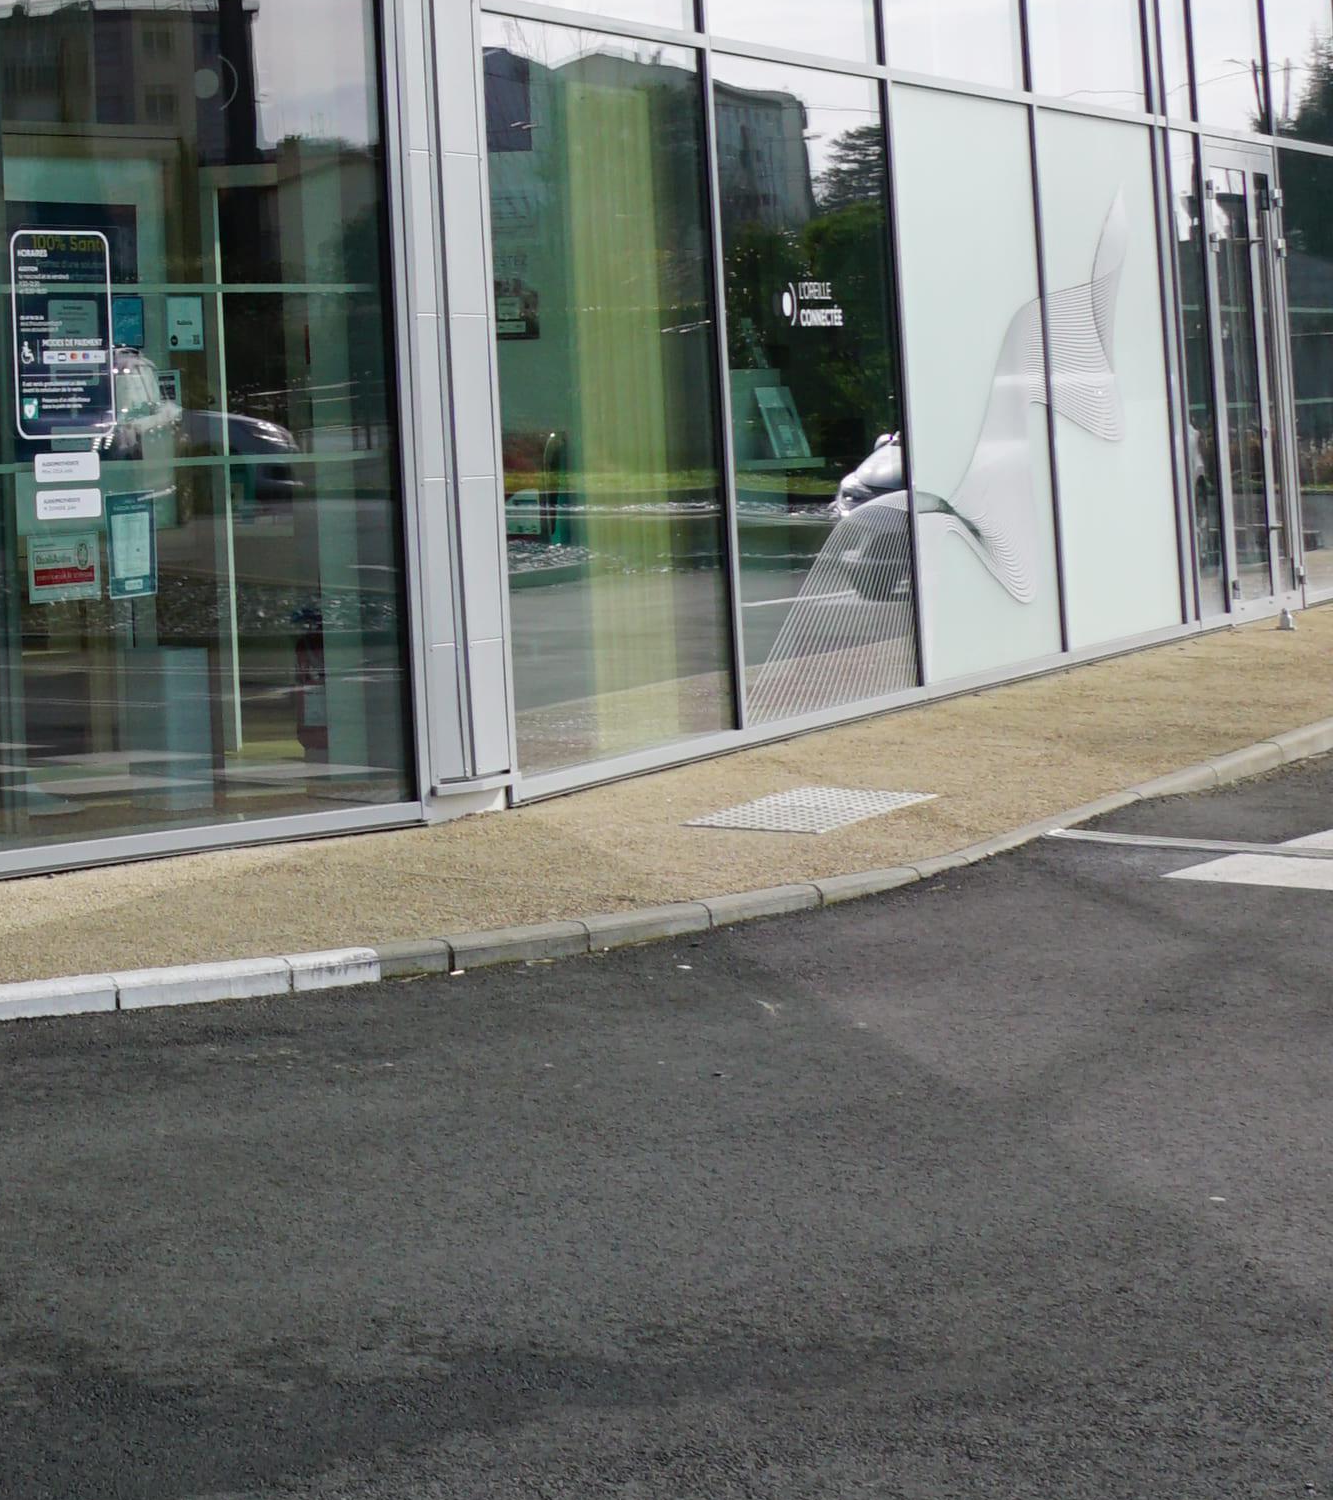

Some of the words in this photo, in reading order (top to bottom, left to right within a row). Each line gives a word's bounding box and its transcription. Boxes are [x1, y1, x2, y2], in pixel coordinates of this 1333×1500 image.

[31, 235, 65, 250] 100%
[798, 282, 832, 299] L'OREILLE
[800, 304, 844, 326] CONNECTÉE
